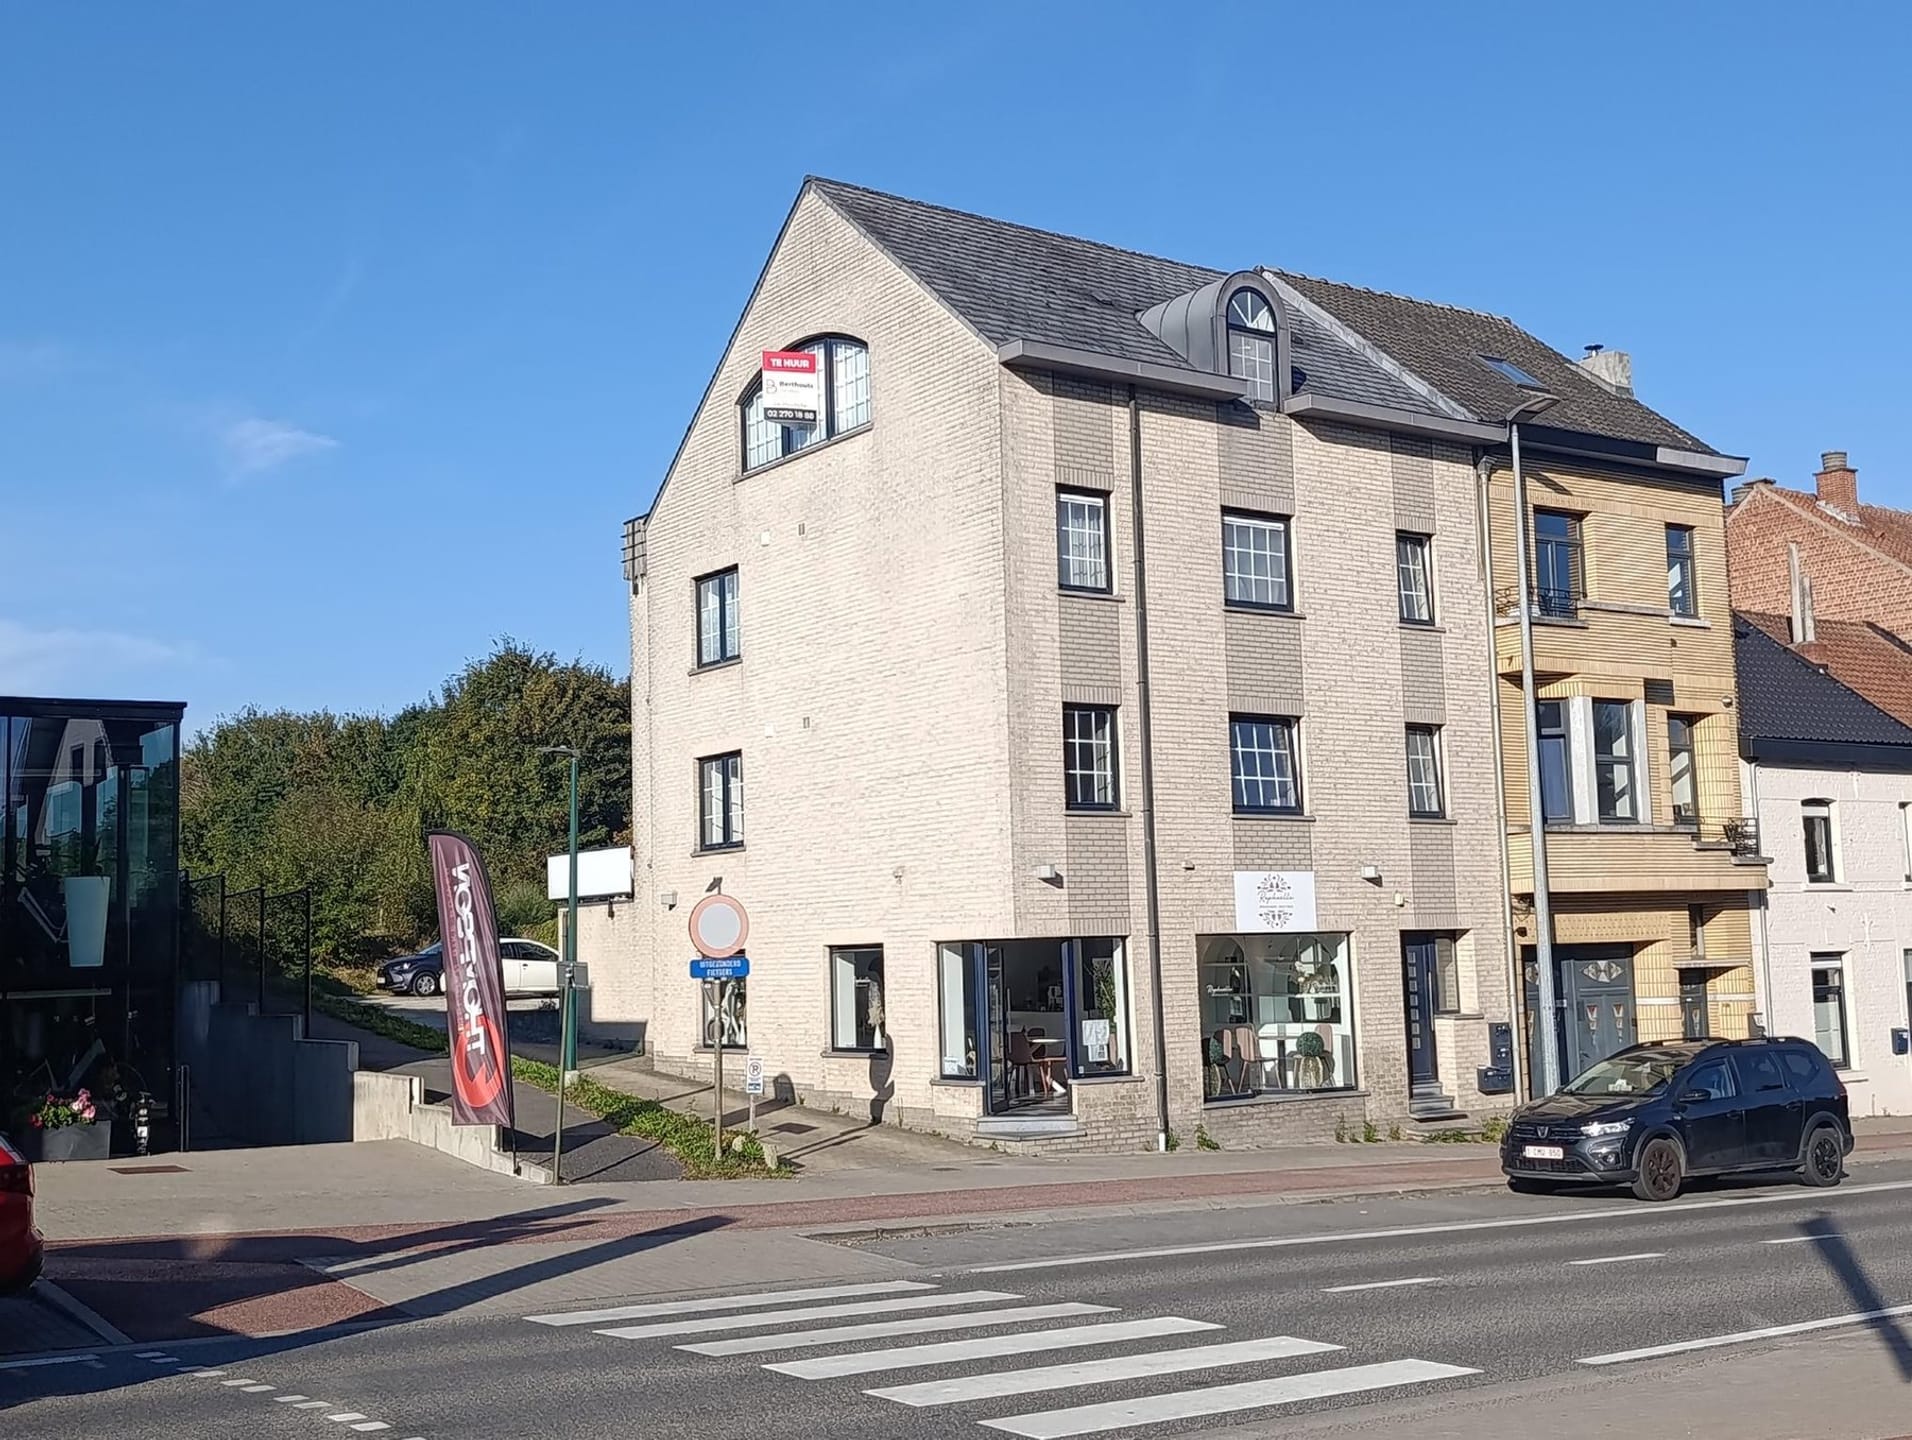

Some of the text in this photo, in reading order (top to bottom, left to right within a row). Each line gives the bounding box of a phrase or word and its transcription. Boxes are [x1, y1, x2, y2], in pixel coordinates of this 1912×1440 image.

[770, 358, 810, 369] TE HUUR
[767, 410, 778, 418] 02
[779, 410, 794, 419] 270
